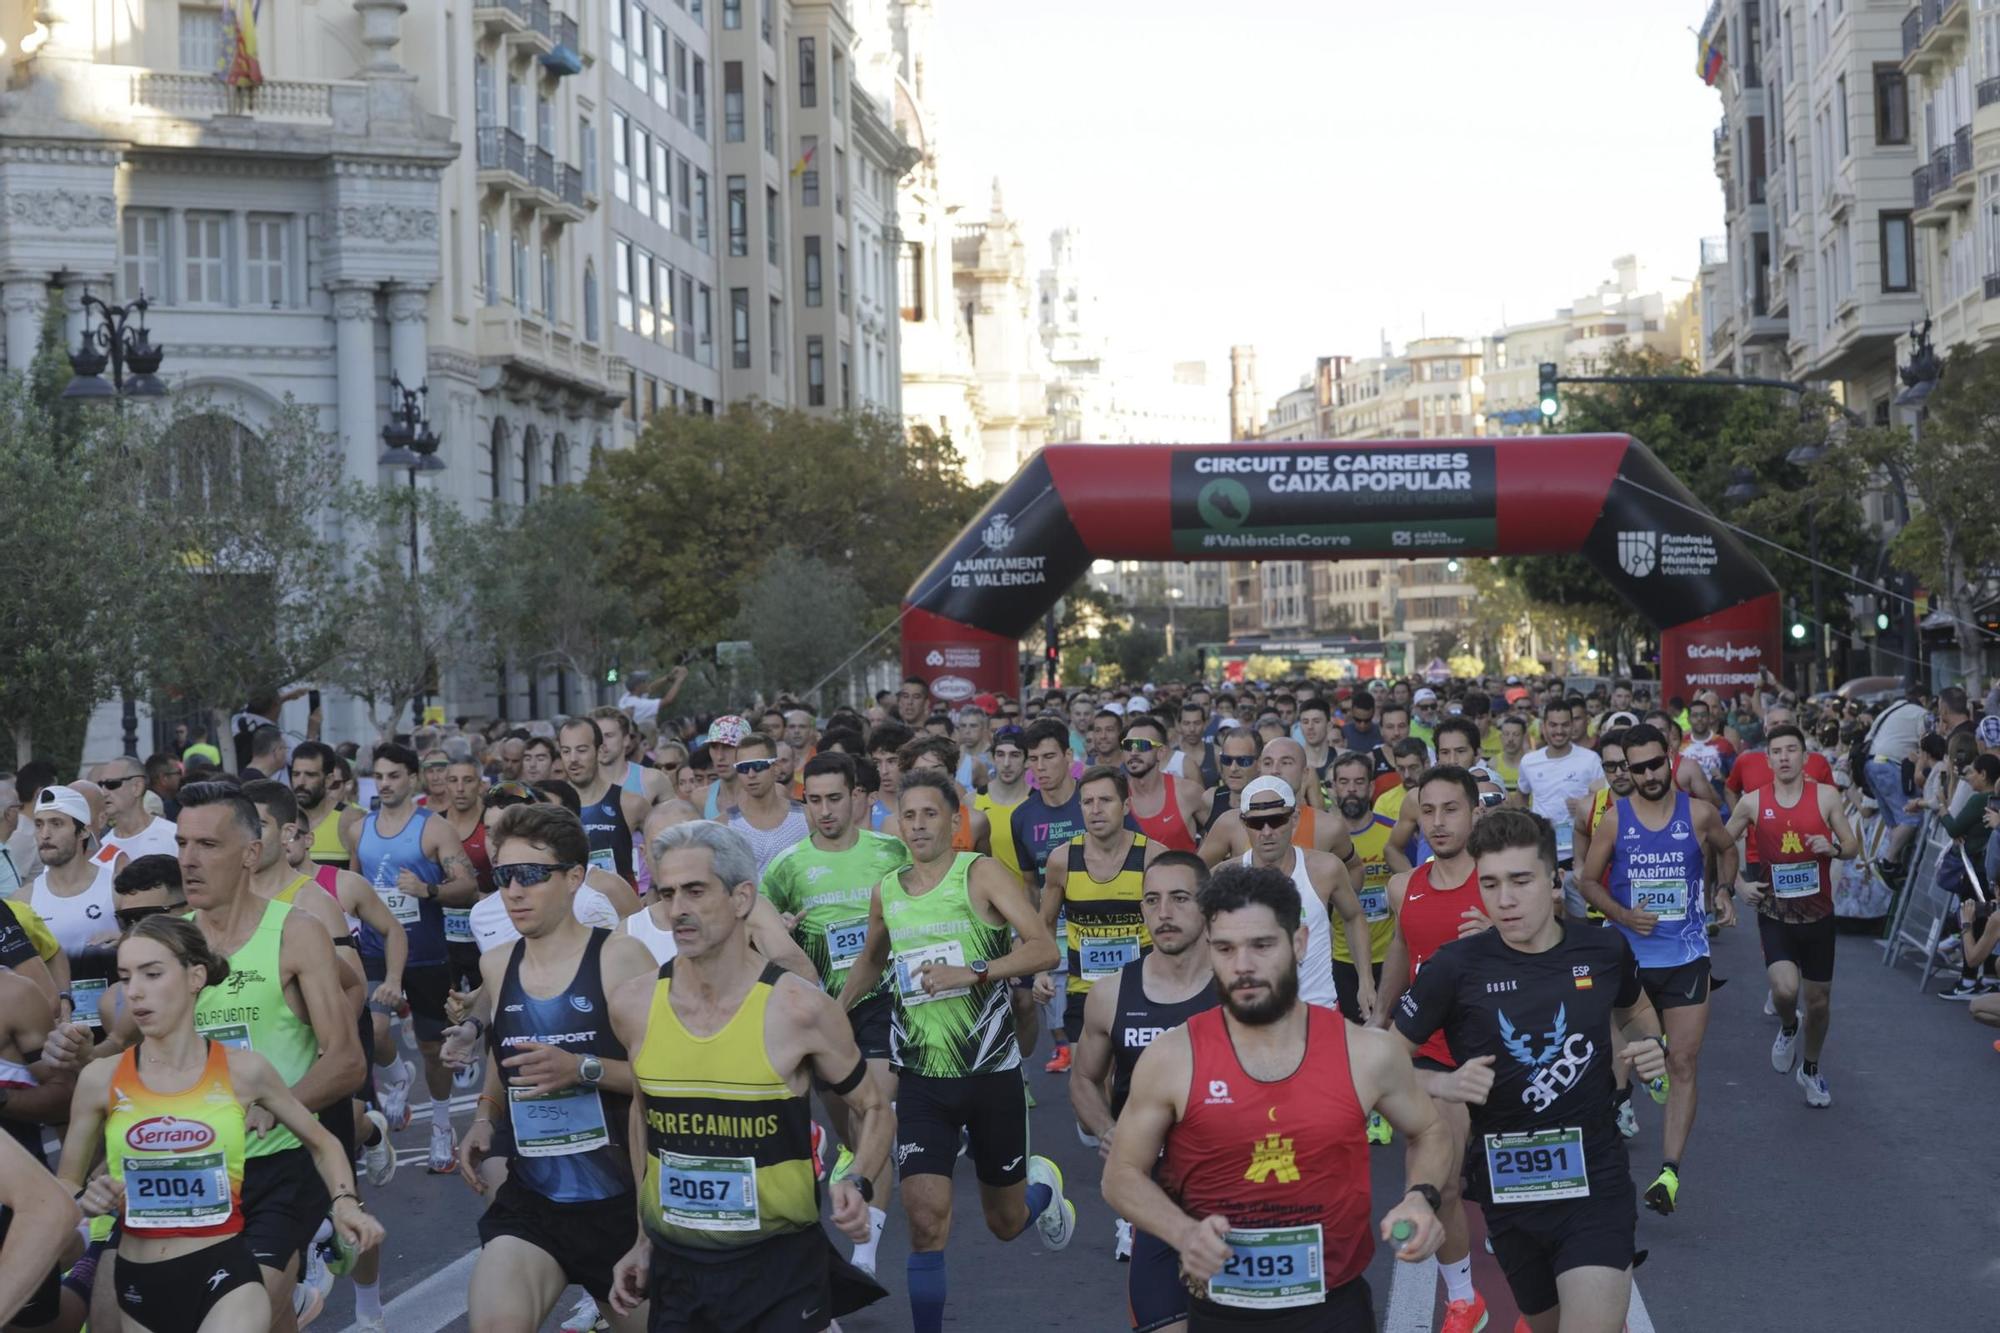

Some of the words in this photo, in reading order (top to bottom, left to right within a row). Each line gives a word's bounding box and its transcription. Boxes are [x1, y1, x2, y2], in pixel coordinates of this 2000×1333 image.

[1195, 456, 1290, 473] CIRCUIT
[1297, 455, 1329, 472] DE
[1334, 453, 1469, 471] CARRERES
[1202, 533, 1351, 548] #ValènciaCorre
[1660, 533, 1713, 545] Fundació
[1660, 544, 1716, 556] Esportiva
[953, 556, 1046, 573] AJUNTAMENT
[1660, 555, 1718, 567] Municipal
[1660, 565, 1711, 576] València
[951, 574, 970, 588] DE
[974, 571, 1046, 587] VALÈNCIA
[1033, 823, 1049, 841] 17
[1630, 851, 1685, 865] POBLATS
[1365, 863, 1393, 875] ers
[1627, 865, 1687, 879] MARÍTIMS
[1778, 873, 1810, 885] 2085
[1360, 897, 1377, 909] 79
[1637, 893, 1675, 904] 2204
[836, 931, 866, 949] 231
[1089, 949, 1123, 964] 2111
[1572, 965, 1590, 977] ESP
[1486, 979, 1518, 994] GOBIK
[526, 1104, 569, 1121] 2554
[134, 1127, 208, 1145] Serrano
[1495, 1147, 1568, 1174] 2991
[137, 1177, 206, 1198] 2004
[668, 1176, 732, 1201] 2067
[1223, 1254, 1294, 1277] 2193
